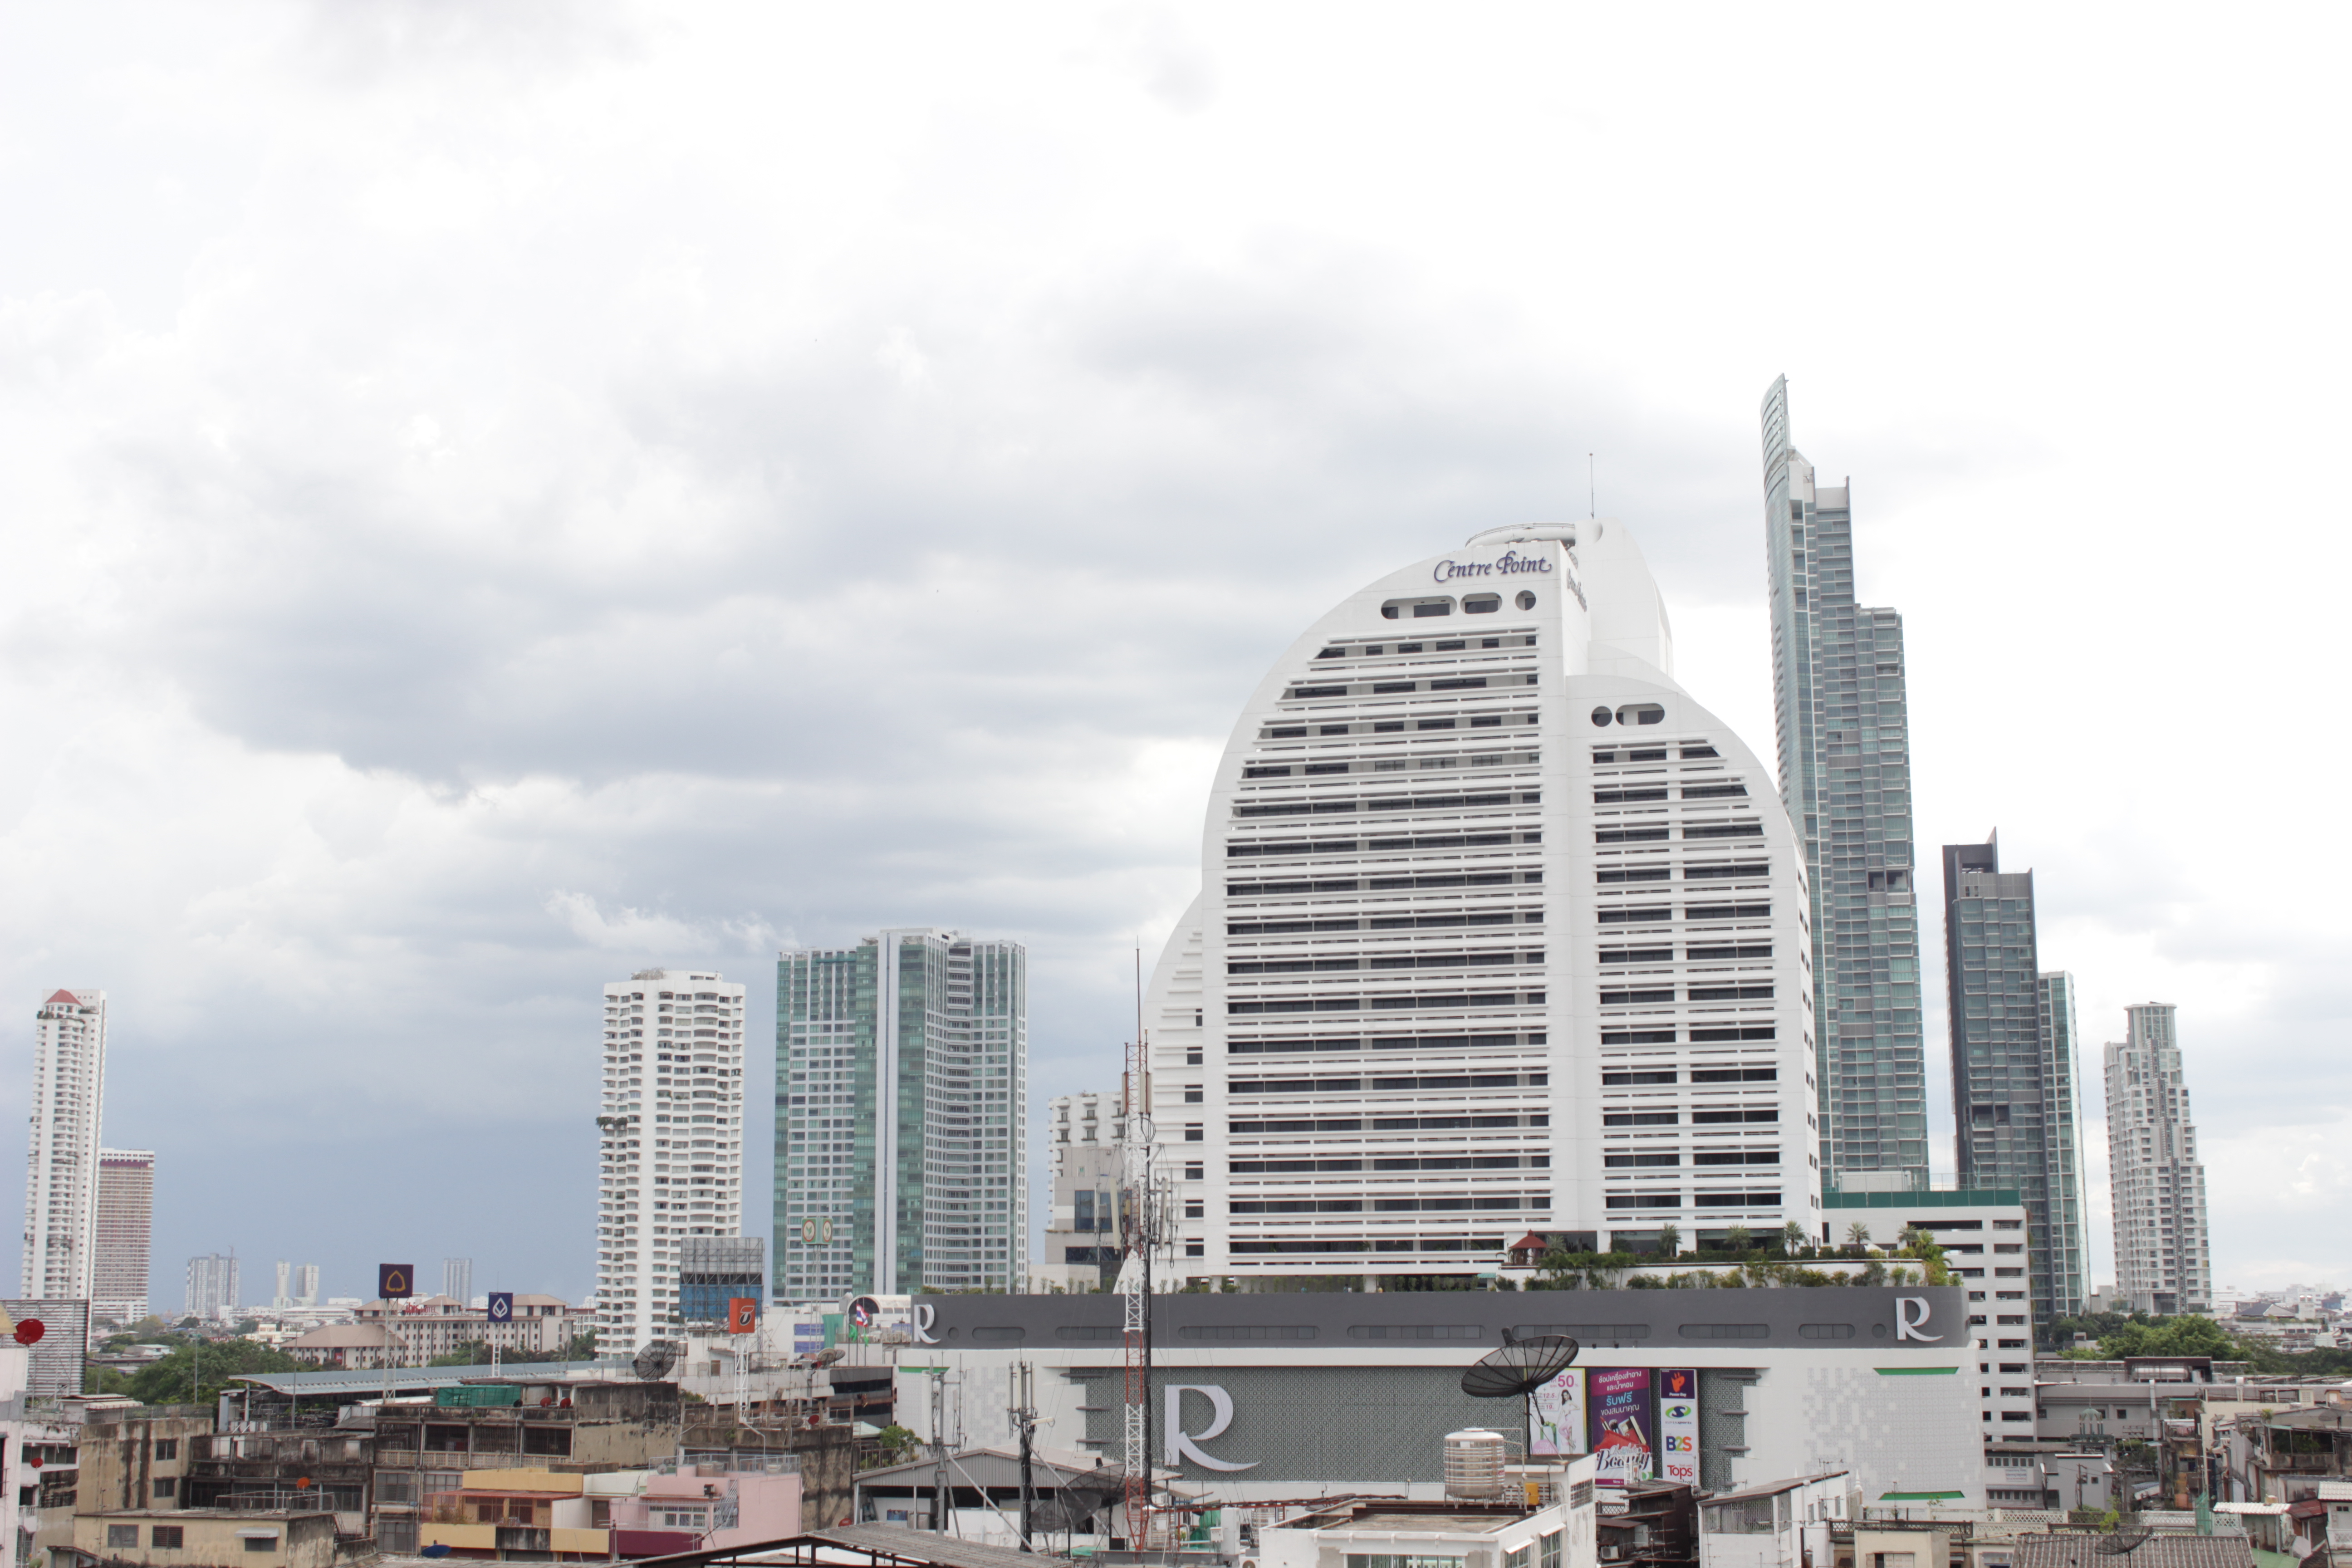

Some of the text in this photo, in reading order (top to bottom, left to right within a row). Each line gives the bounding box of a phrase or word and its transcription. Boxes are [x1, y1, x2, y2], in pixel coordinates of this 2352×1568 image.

[1434, 550, 1552, 583] Centre Point
[914, 1304, 941, 1344] R
[1896, 1296, 1944, 1342] R
[1601, 1404, 1639, 1416] ของสมนาคุณ
[1606, 1391, 1632, 1406] รับฟรี
[1165, 1384, 1260, 1471] R
[1666, 1436, 1692, 1452] B2S
[1667, 1465, 1693, 1480] Tops
